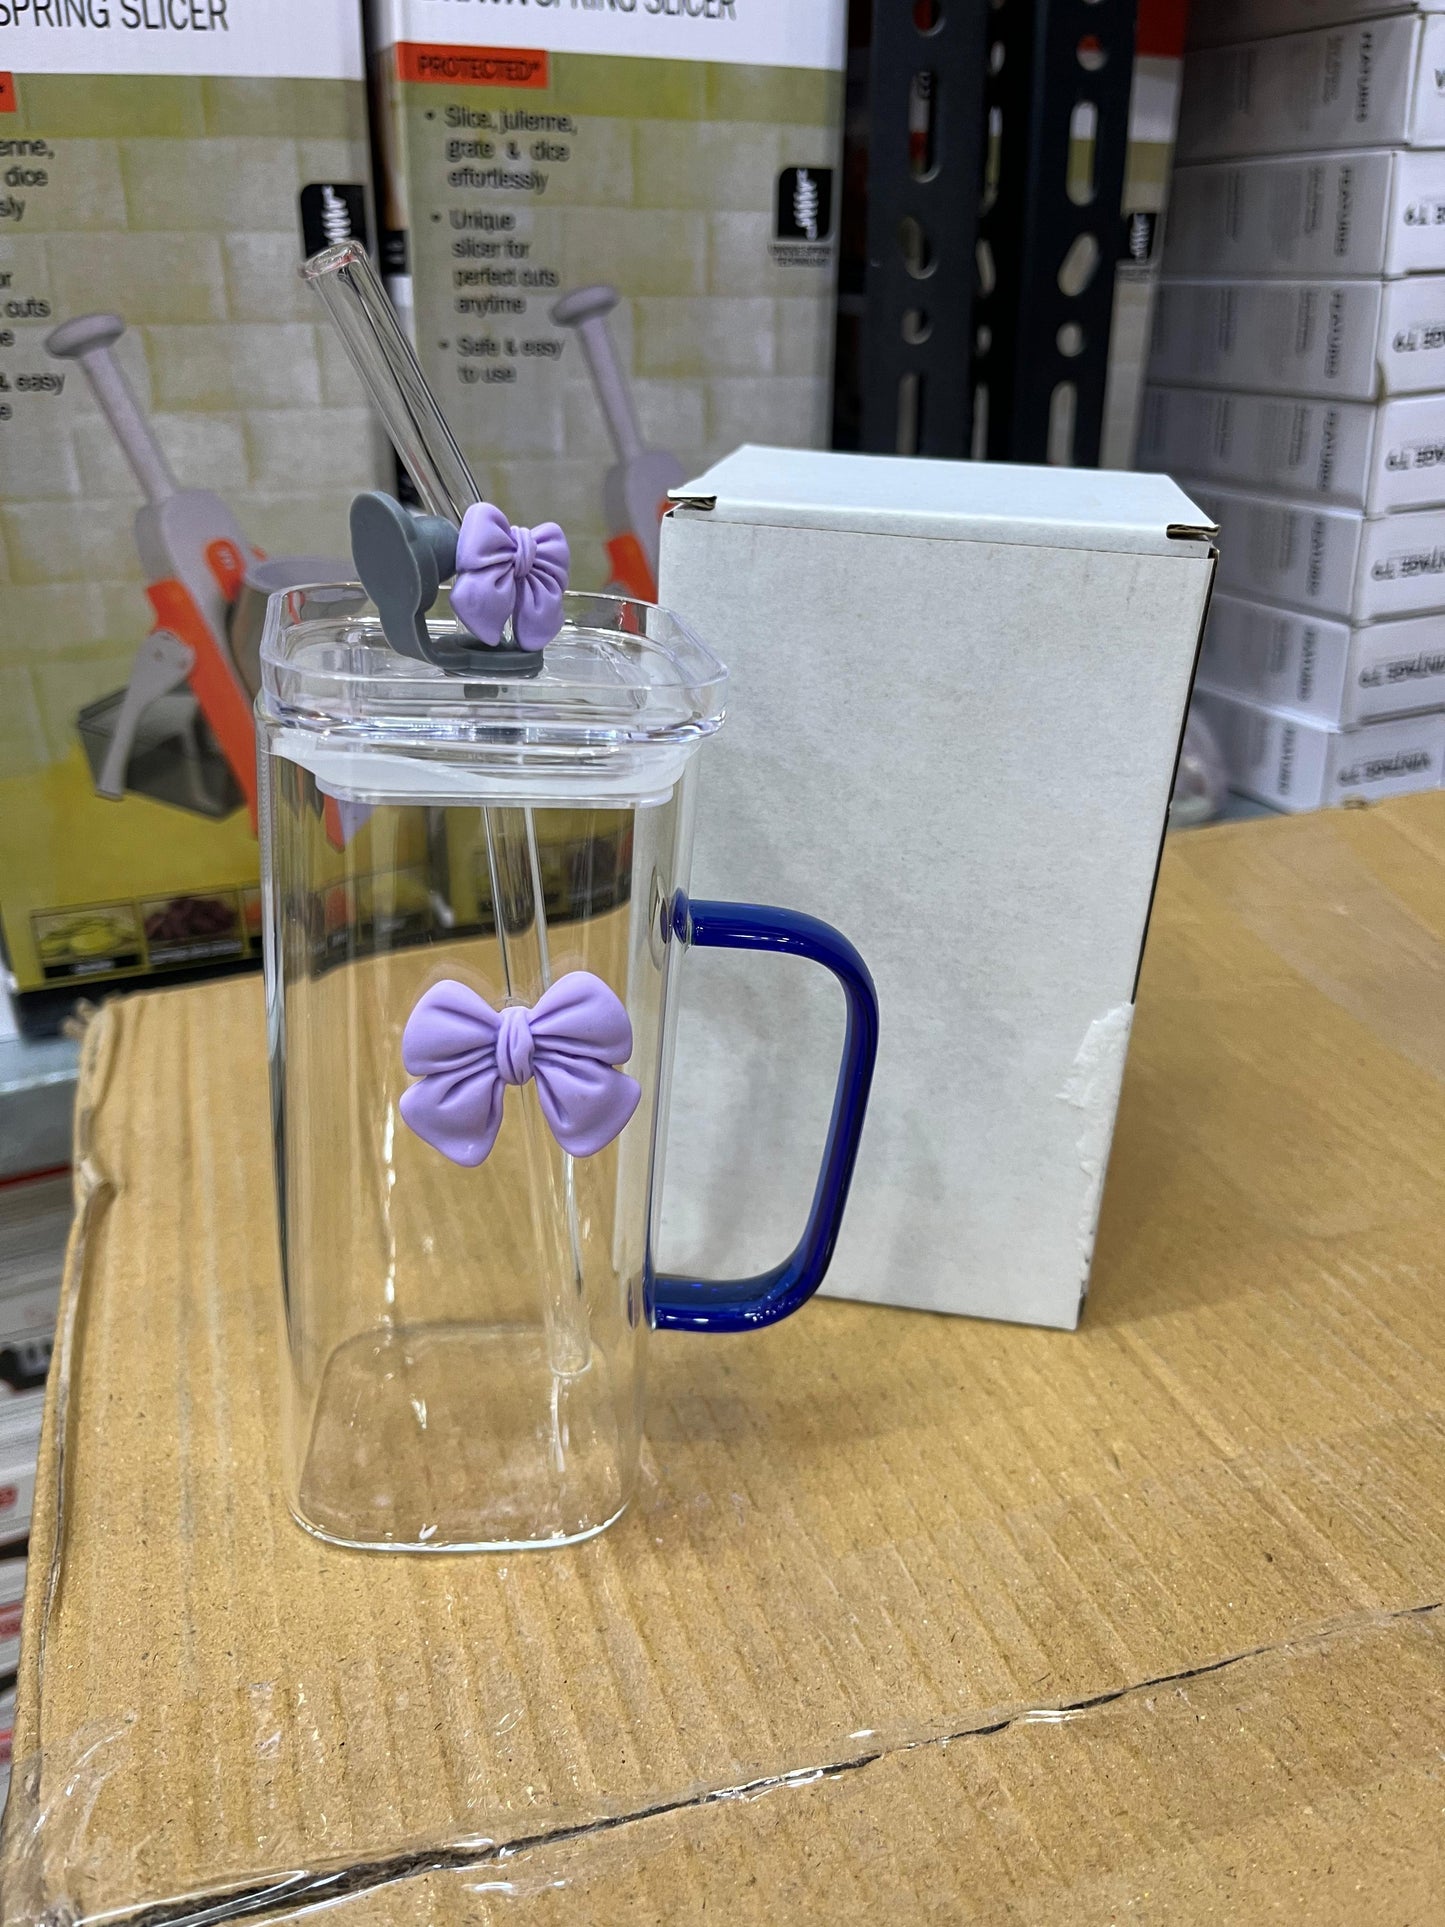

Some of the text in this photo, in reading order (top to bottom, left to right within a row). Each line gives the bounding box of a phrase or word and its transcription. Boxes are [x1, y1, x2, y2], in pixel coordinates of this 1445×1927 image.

[120, 0, 229, 31] SLICER
[500, 107, 577, 136] julienne,
[446, 140, 496, 163] grate
[530, 140, 570, 161] dice
[5, 165, 48, 187] dice
[448, 168, 549, 195] effortlessly
[450, 210, 516, 233] Unique
[451, 238, 532, 258] slicer for
[454, 268, 560, 290] perfect cuts
[5, 297, 51, 318] cuts
[455, 295, 526, 317] anytime
[457, 334, 499, 356] Safe
[521, 339, 565, 360] easy
[15, 374, 65, 396] easy
[459, 365, 517, 383] to use
